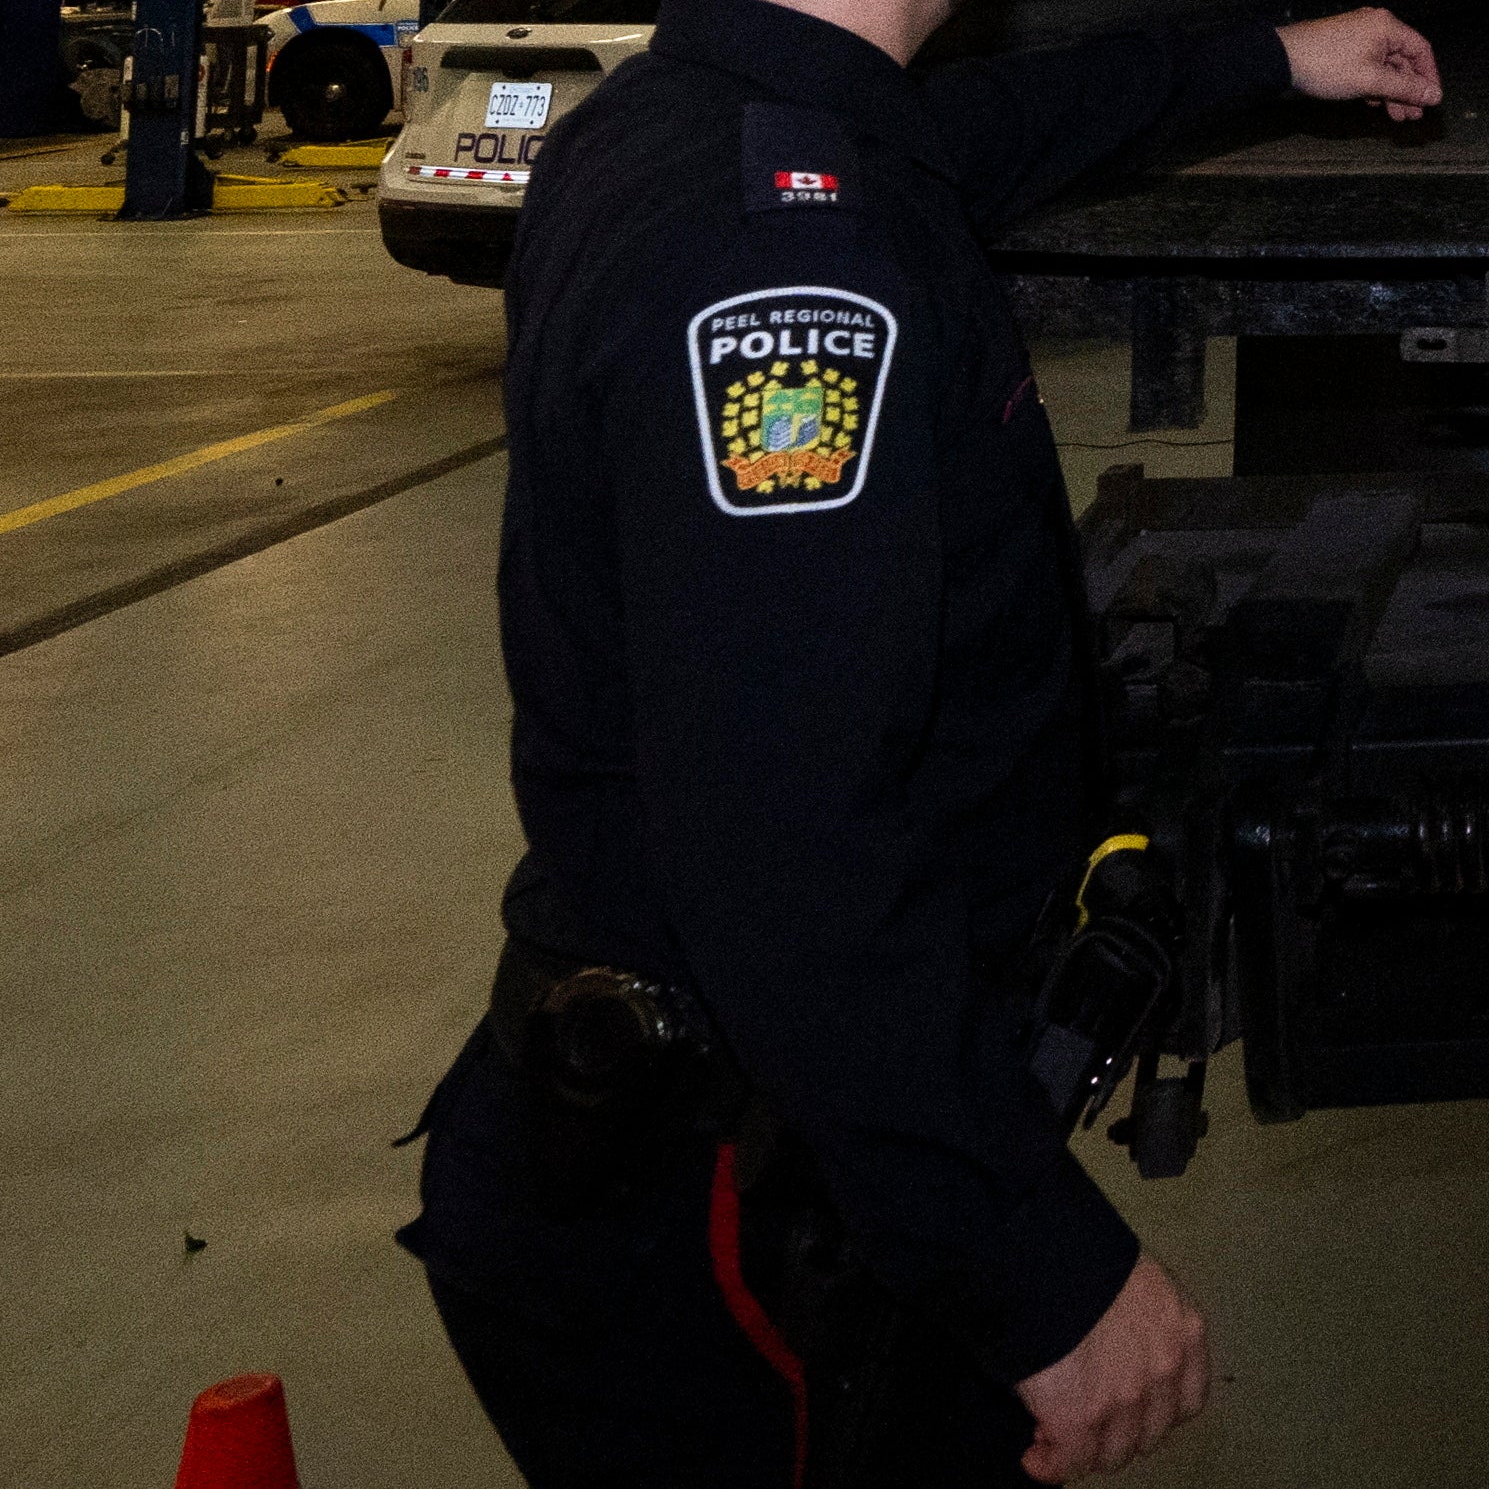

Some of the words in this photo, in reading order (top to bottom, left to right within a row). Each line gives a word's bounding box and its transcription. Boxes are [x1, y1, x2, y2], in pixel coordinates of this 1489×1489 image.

[524, 95, 546, 116] 773
[454, 132, 546, 164] POLIC
[711, 313, 761, 333] PEEL
[769, 309, 875, 328] REGIONAL
[709, 328, 876, 365] POLICE
